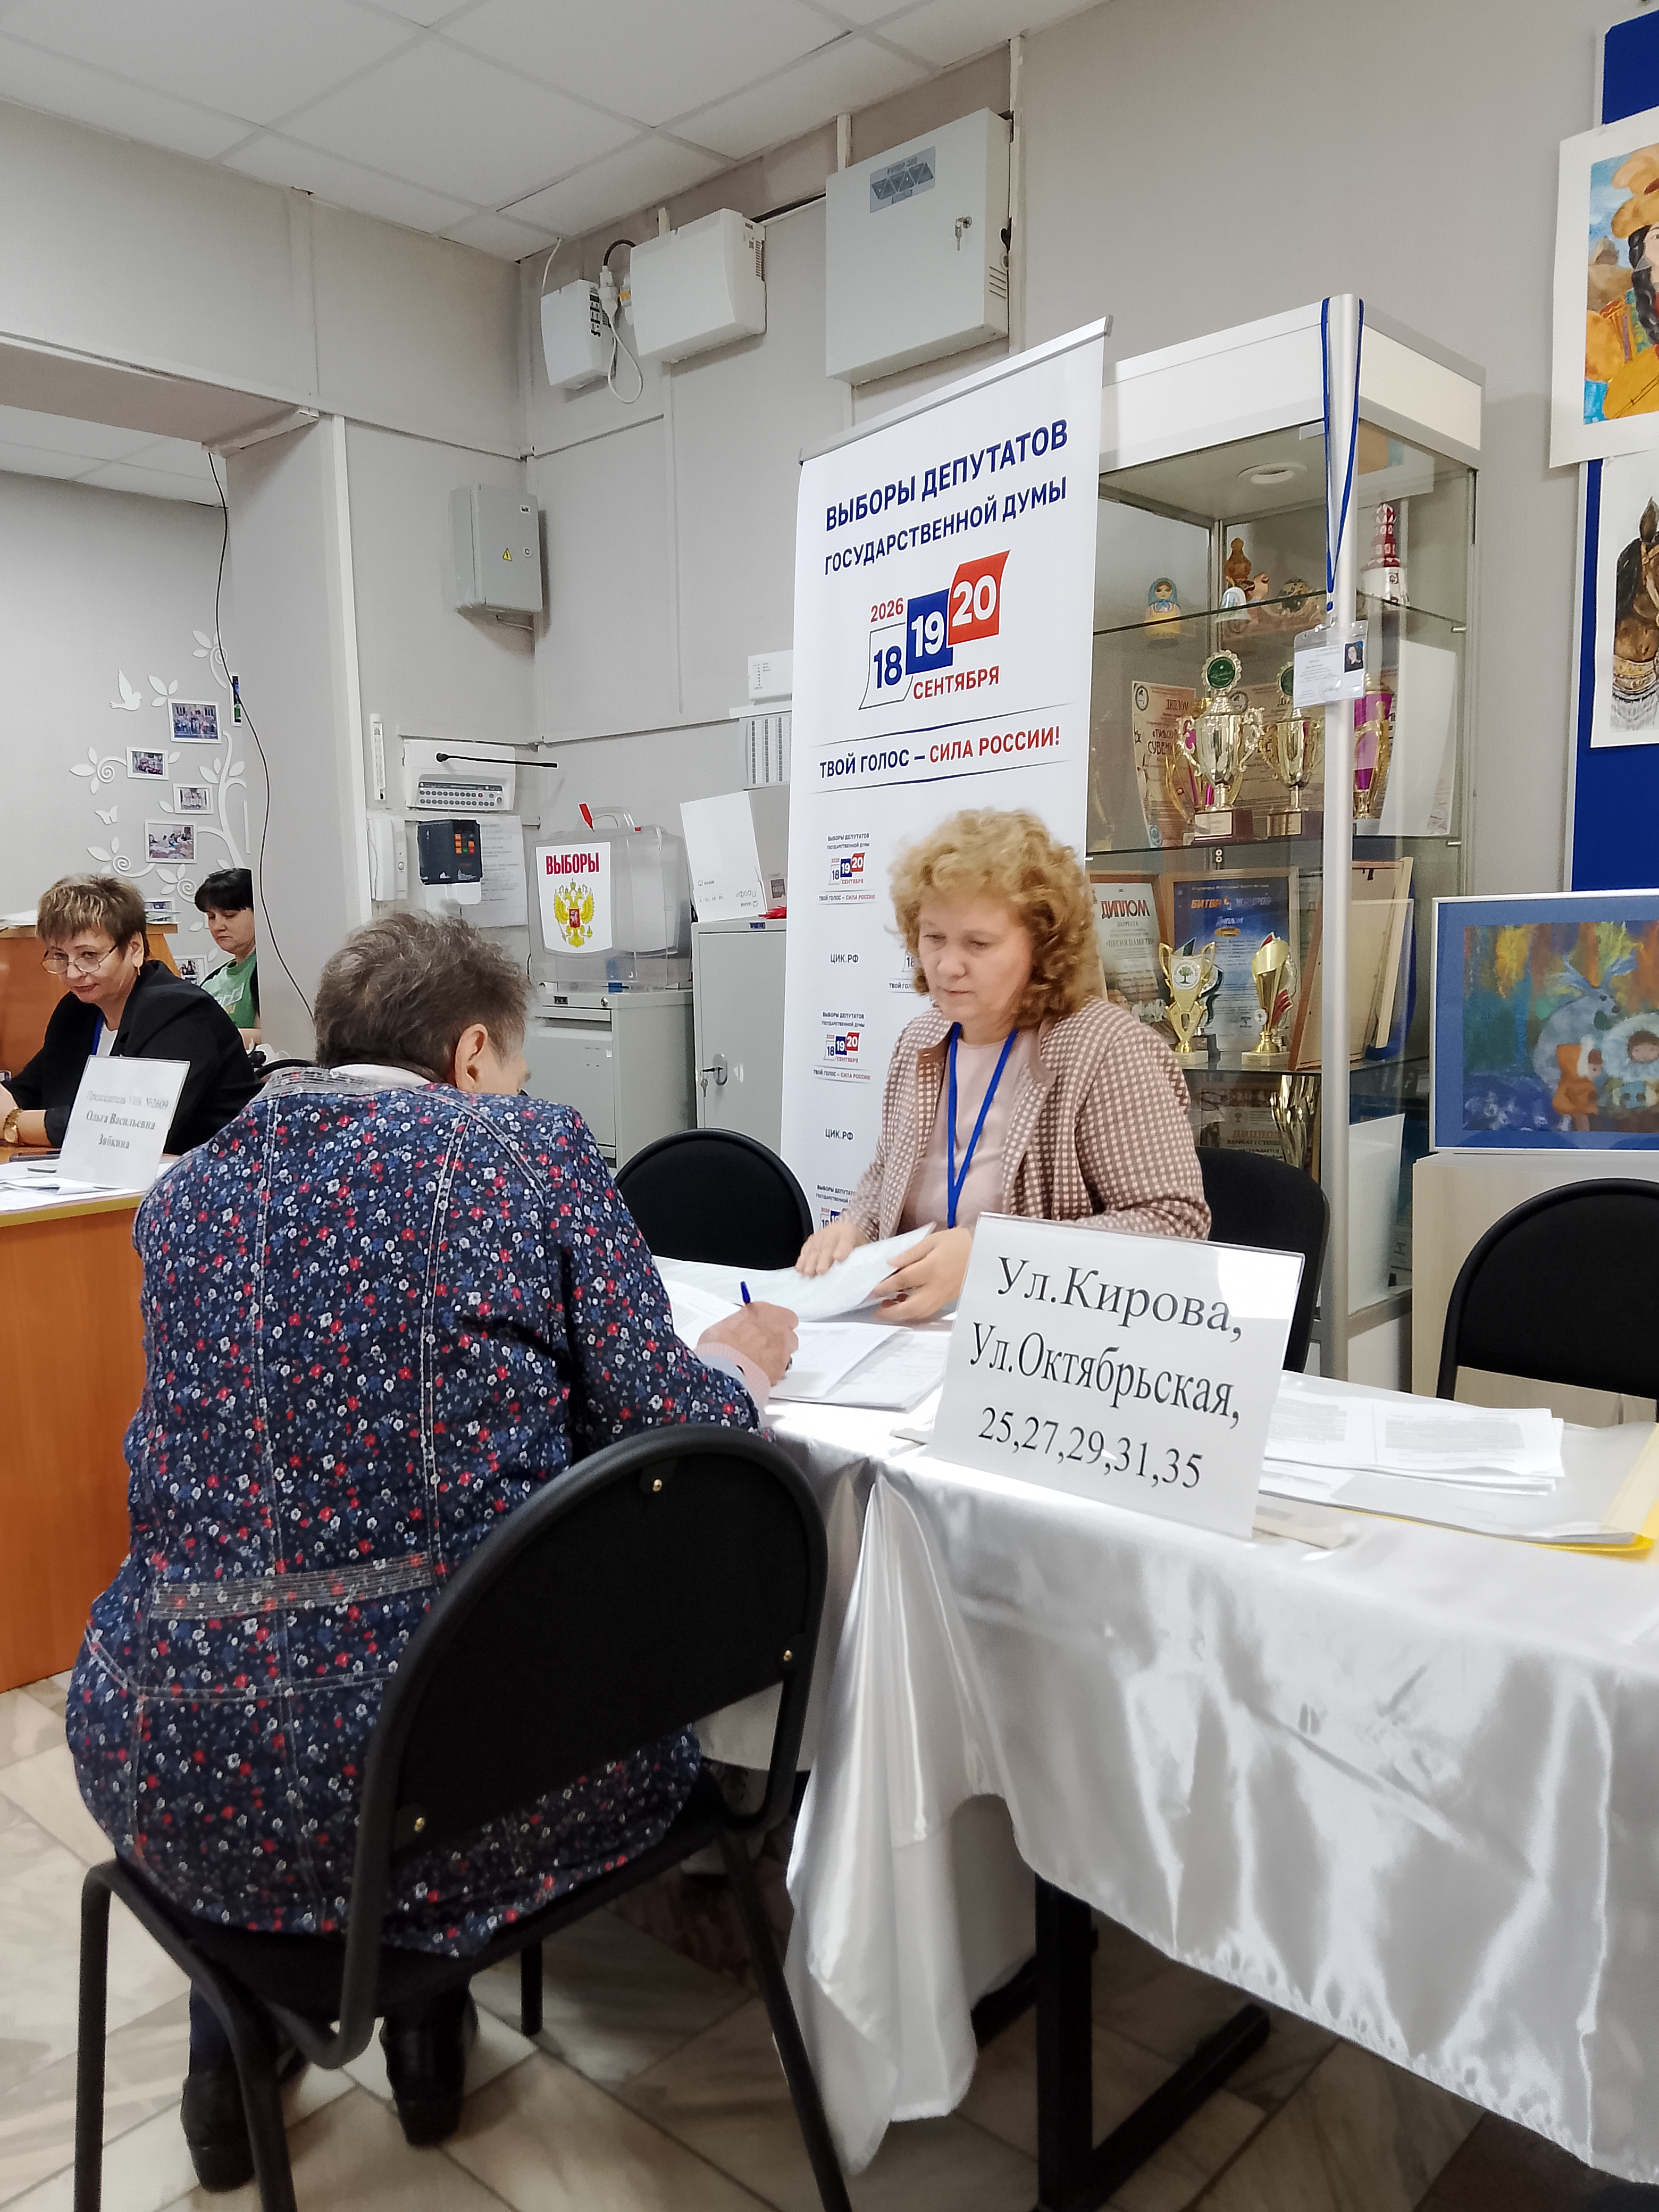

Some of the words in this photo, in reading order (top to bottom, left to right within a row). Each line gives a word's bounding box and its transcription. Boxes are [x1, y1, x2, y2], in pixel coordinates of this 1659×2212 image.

[826, 479, 915, 532] ВЫБОРЫ
[921, 419, 1068, 502] ДЕПУТАТОВ
[825, 496, 996, 575] ГОСУДАРСТВЕННОЙ
[1002, 476, 1066, 522] ДУМЫ
[870, 598, 904, 623] 2026
[873, 646, 902, 689] 18
[909, 611, 944, 657] 19
[952, 575, 997, 627] 20
[913, 665, 999, 700] СЕНТЯБРЯ
[1166, 699, 1189, 710] ДИПЛОМ
[820, 752, 856, 778] ТВОЙ
[860, 749, 910, 773] ГОЛОС
[930, 741, 973, 764] СИЛА
[979, 725, 1060, 756] РОССИИ!
[546, 852, 599, 875] ВЫБОРЫ
[832, 869, 839, 881] 18
[841, 862, 850, 874] 19
[852, 857, 863, 868] 20
[1101, 899, 1150, 919] ДИПЛОМ
[830, 954, 859, 963] ЦИК.РФ
[827, 1045, 834, 1056] 18
[836, 1041, 845, 1051] 19
[847, 1036, 858, 1047] 20
[86, 1110, 108, 1122] Ольга
[110, 1113, 156, 1130] Васильевна
[98, 1134, 130, 1149] Зябкина
[825, 1128, 853, 1141] ЦИК.РФ
[835, 1188, 856, 1196] ДЕПУТАТО
[997, 1256, 1243, 1343] Ул.Кирова,
[970, 1322, 1240, 1429] Ул.Октябрьская,
[978, 1406, 1203, 1489] 25,27,29,31,35
